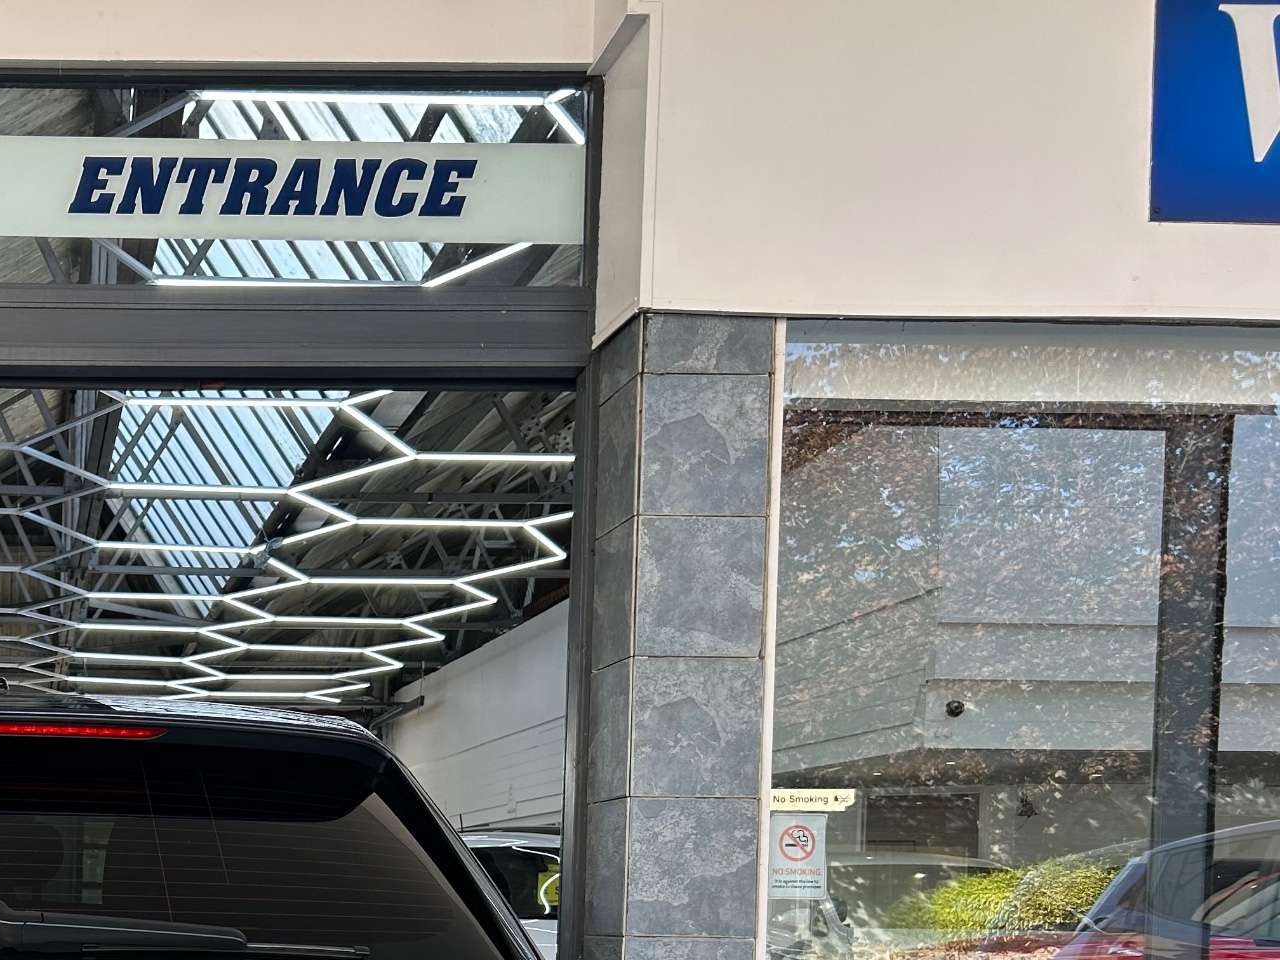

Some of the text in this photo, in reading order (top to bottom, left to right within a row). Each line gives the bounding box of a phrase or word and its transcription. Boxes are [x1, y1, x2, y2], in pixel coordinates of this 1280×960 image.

[68, 156, 478, 218] ENTRANCE
[773, 795, 829, 805] No Smoking
